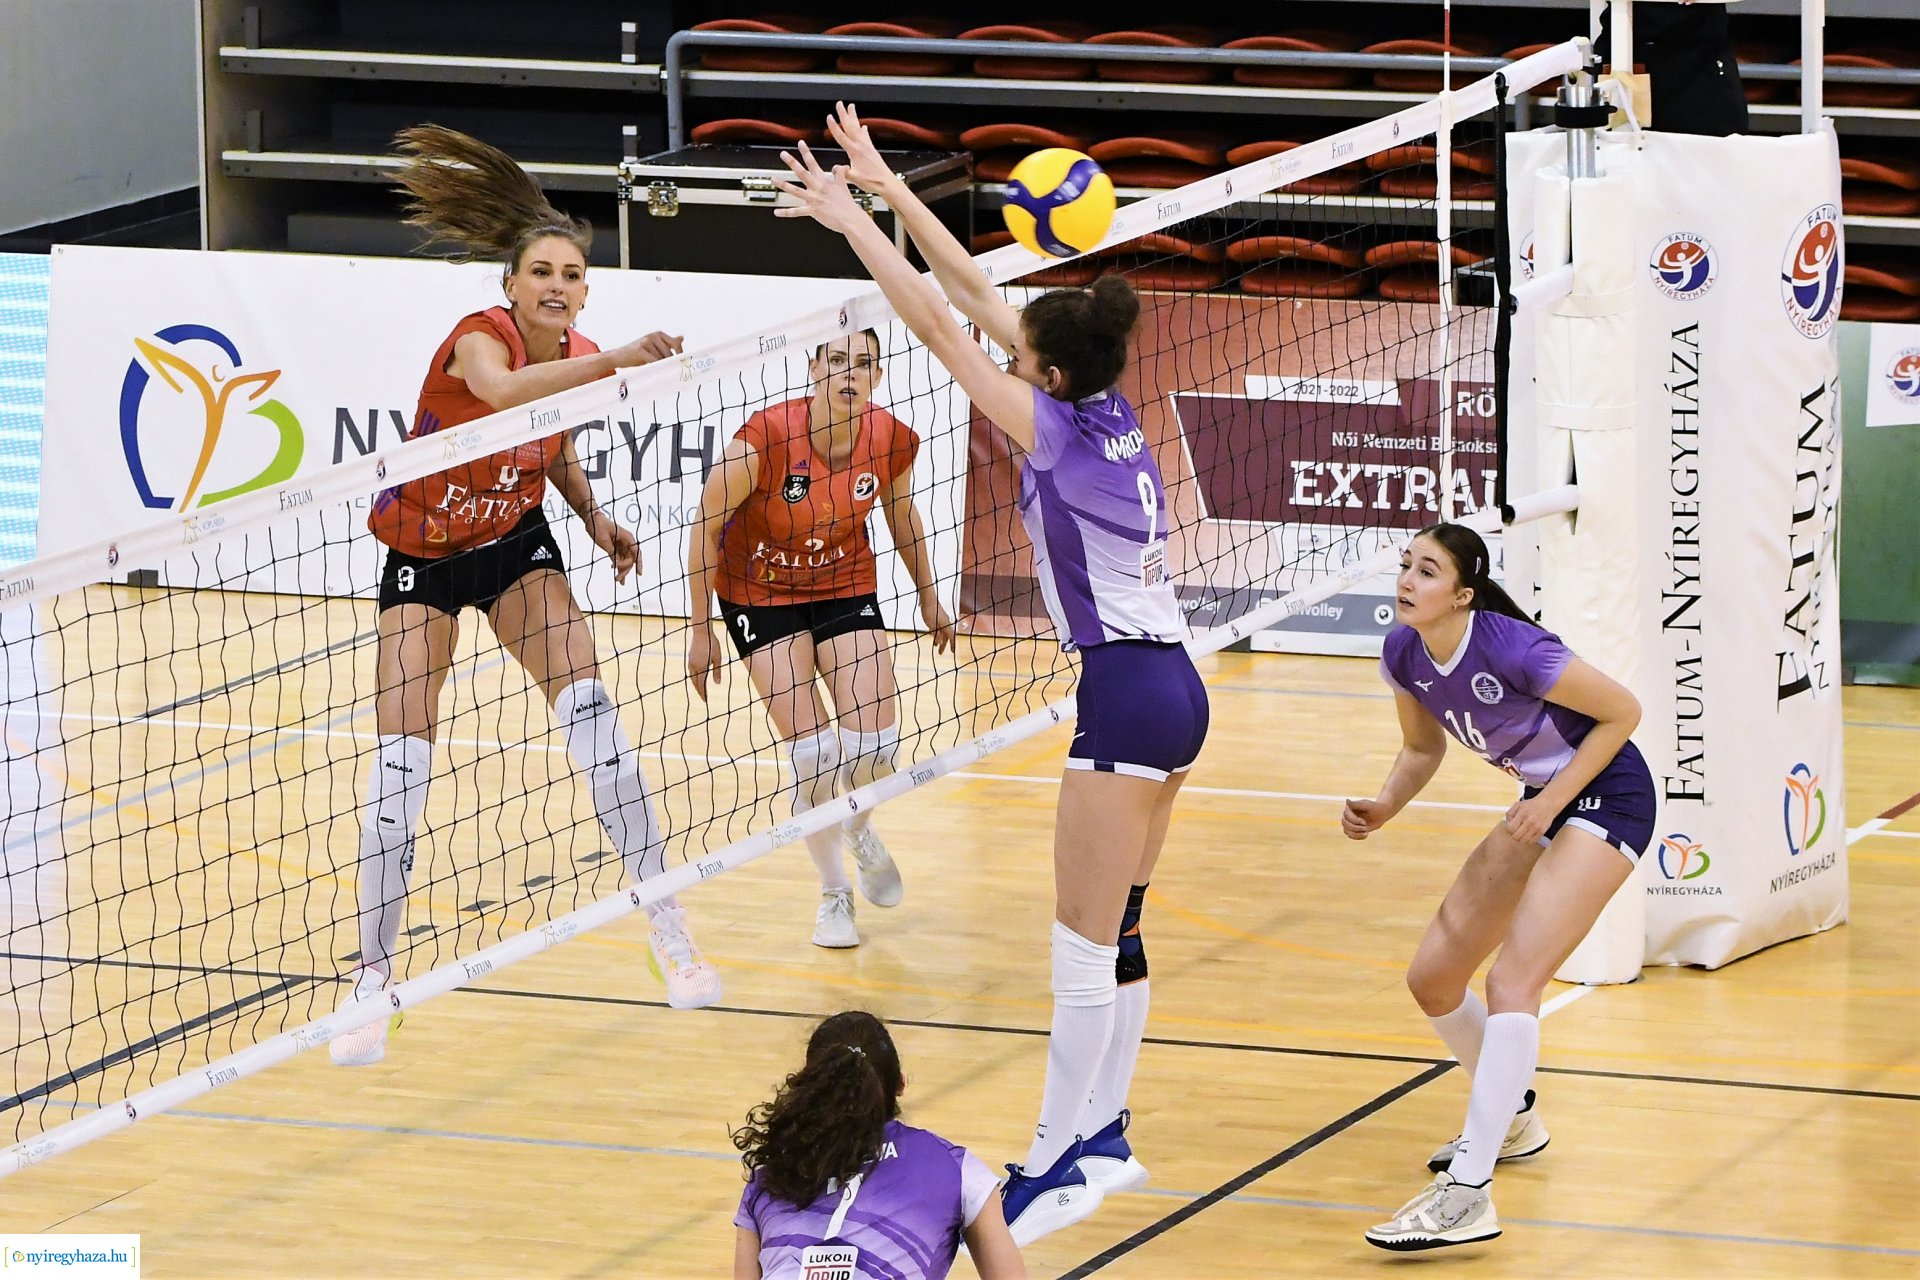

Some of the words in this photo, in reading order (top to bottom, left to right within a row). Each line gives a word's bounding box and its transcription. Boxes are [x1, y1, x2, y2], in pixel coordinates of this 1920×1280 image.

[1668, 233, 1703, 244] FATUM
[1293, 383, 1359, 397] 2021-2022
[1363, 434, 1427, 450] Nemzeti
[1137, 471, 1158, 544] 9
[1775, 375, 1826, 714] FATUM
[1661, 320, 1705, 806] FATUM-NYÍREGYHÁZA
[397, 566, 415, 592] 9
[736, 613, 757, 643] 2
[1445, 710, 1488, 750] 16
[1770, 852, 1836, 894] NYÍREGYHÁZA
[1647, 884, 1723, 896] NYÍREGYHÁZA
[809, 1253, 853, 1263] LUKOIL
